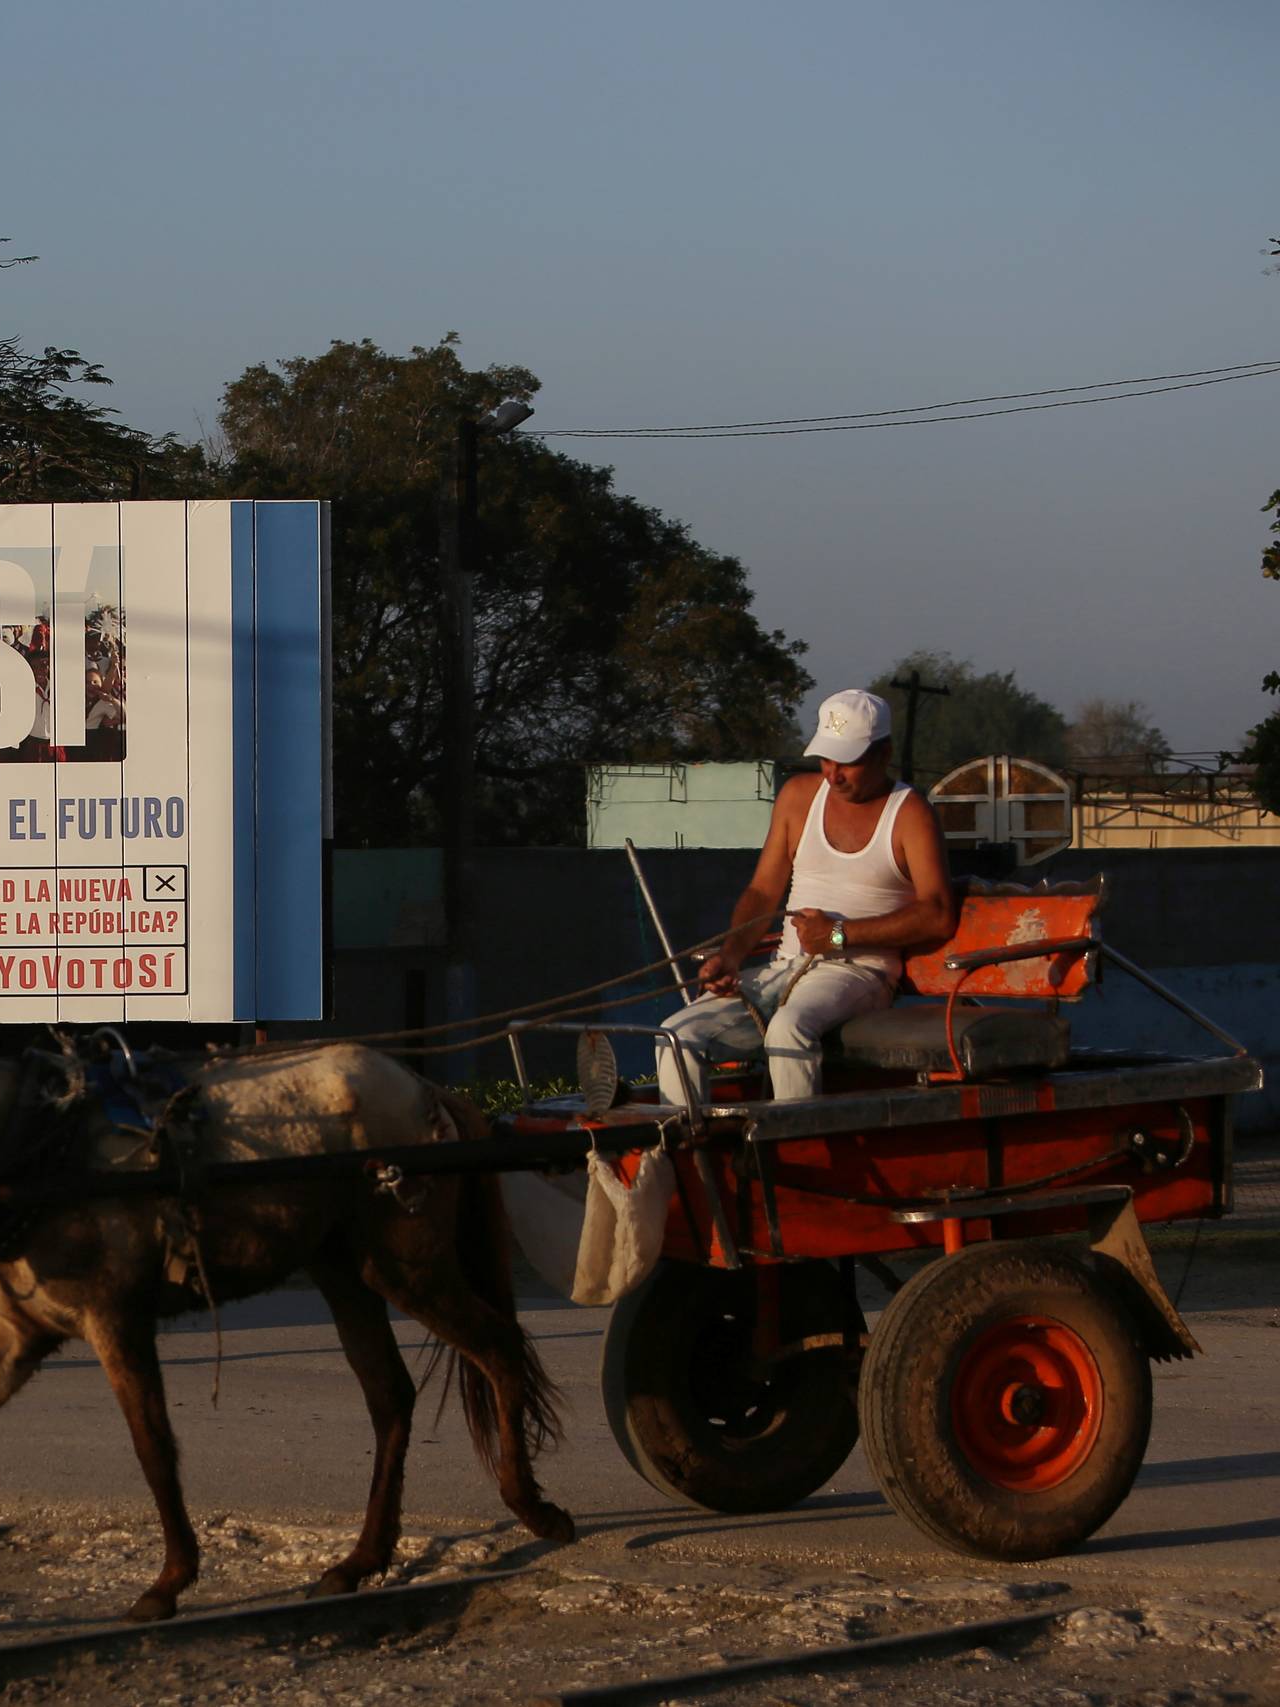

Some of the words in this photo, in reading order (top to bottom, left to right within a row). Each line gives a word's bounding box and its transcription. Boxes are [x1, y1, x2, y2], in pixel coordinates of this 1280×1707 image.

[9, 798, 46, 840] EL
[59, 796, 184, 839] FUTURO
[24, 879, 51, 902] LA
[59, 878, 133, 902] NUEVA
[16, 912, 41, 934] LA
[49, 909, 178, 934] REPÚBLICA?
